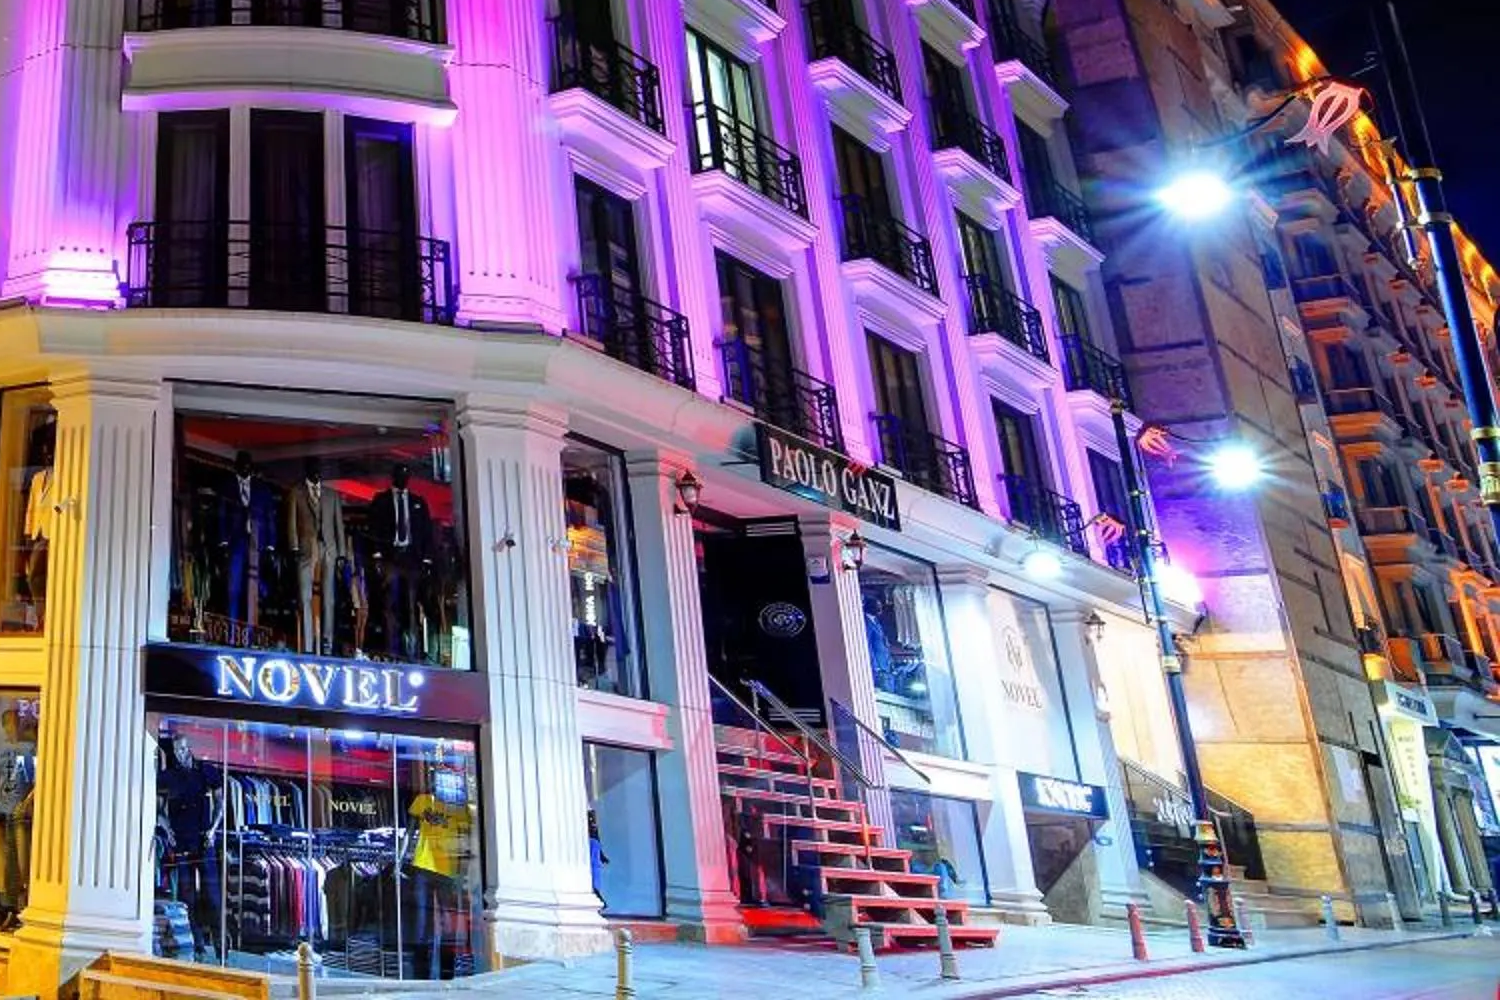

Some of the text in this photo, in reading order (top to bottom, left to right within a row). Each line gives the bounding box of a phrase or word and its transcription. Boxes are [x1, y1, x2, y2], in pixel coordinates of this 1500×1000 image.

[769, 437, 896, 530] PAOLO GANZ
[216, 654, 419, 712] NOVEL
[330, 799, 377, 815] NOVEL
